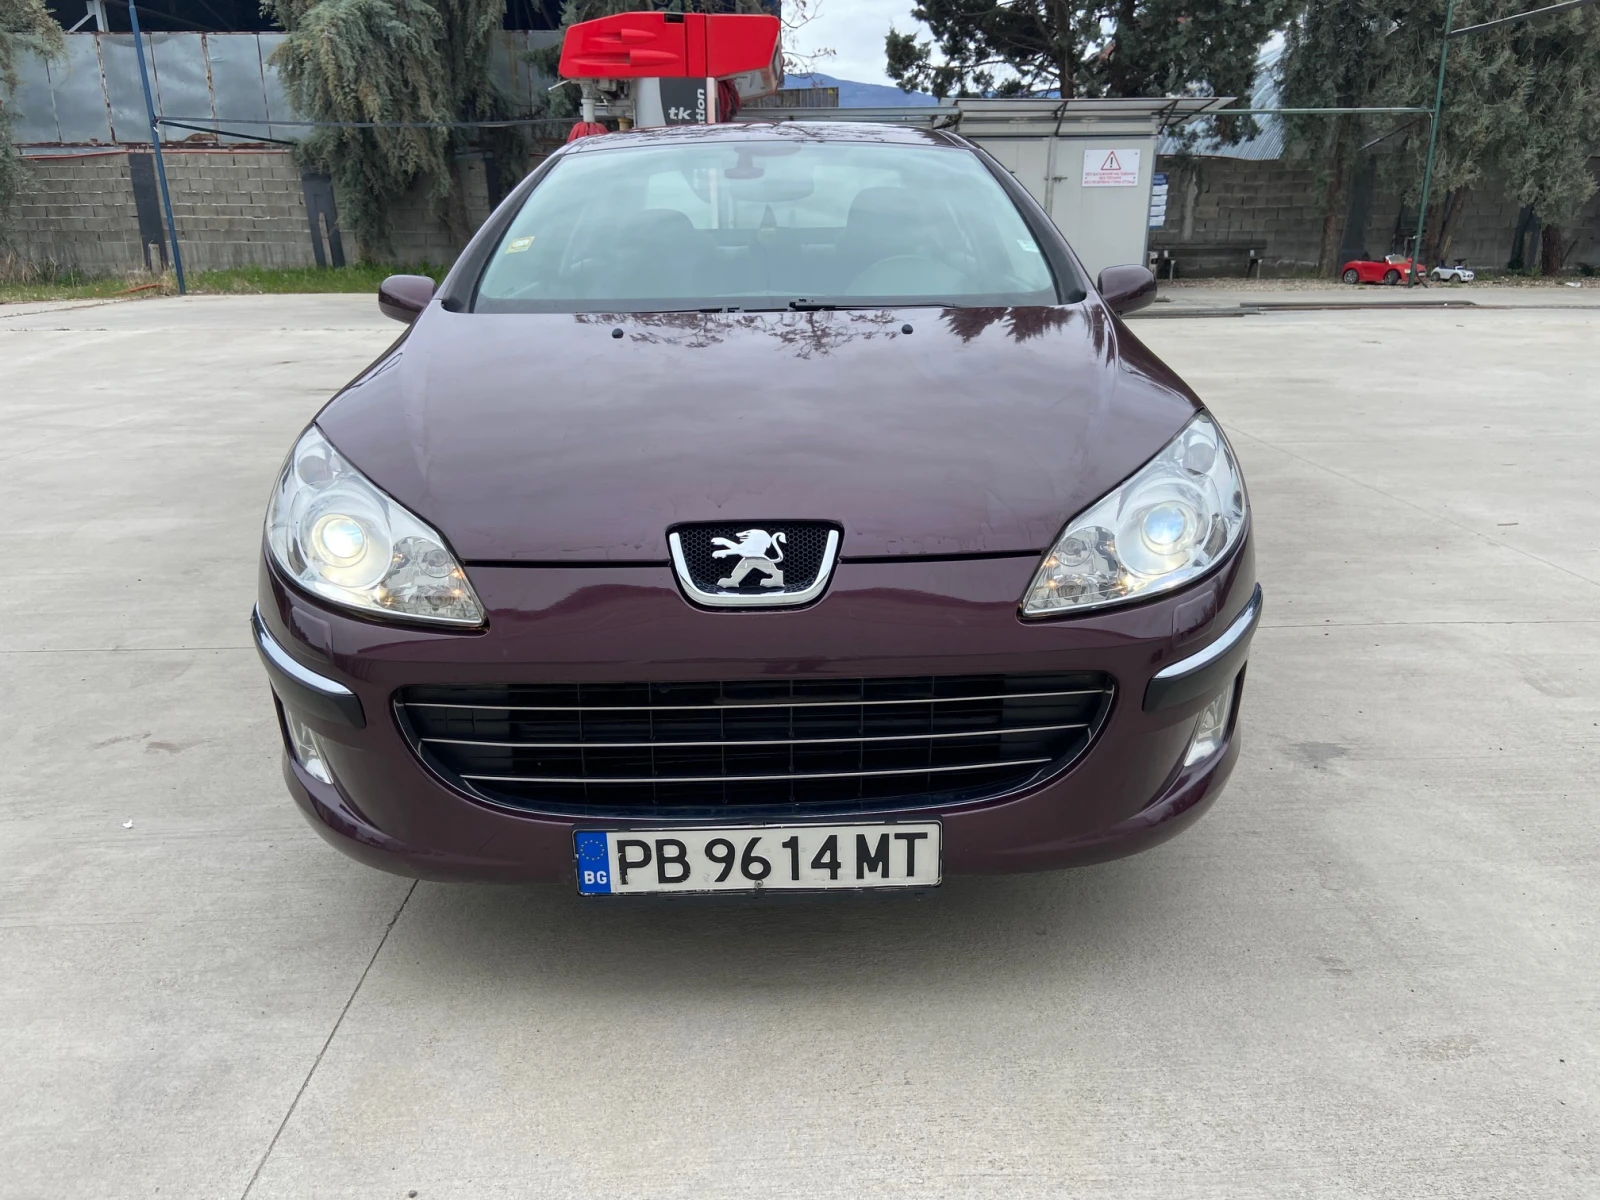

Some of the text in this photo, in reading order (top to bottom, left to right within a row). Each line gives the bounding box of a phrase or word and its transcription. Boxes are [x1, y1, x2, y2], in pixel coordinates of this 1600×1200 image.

[668, 107, 692, 120] tk
[696, 89, 705, 124] tion
[616, 832, 928, 885] PB 9614 MT
[584, 870, 607, 885] BG
